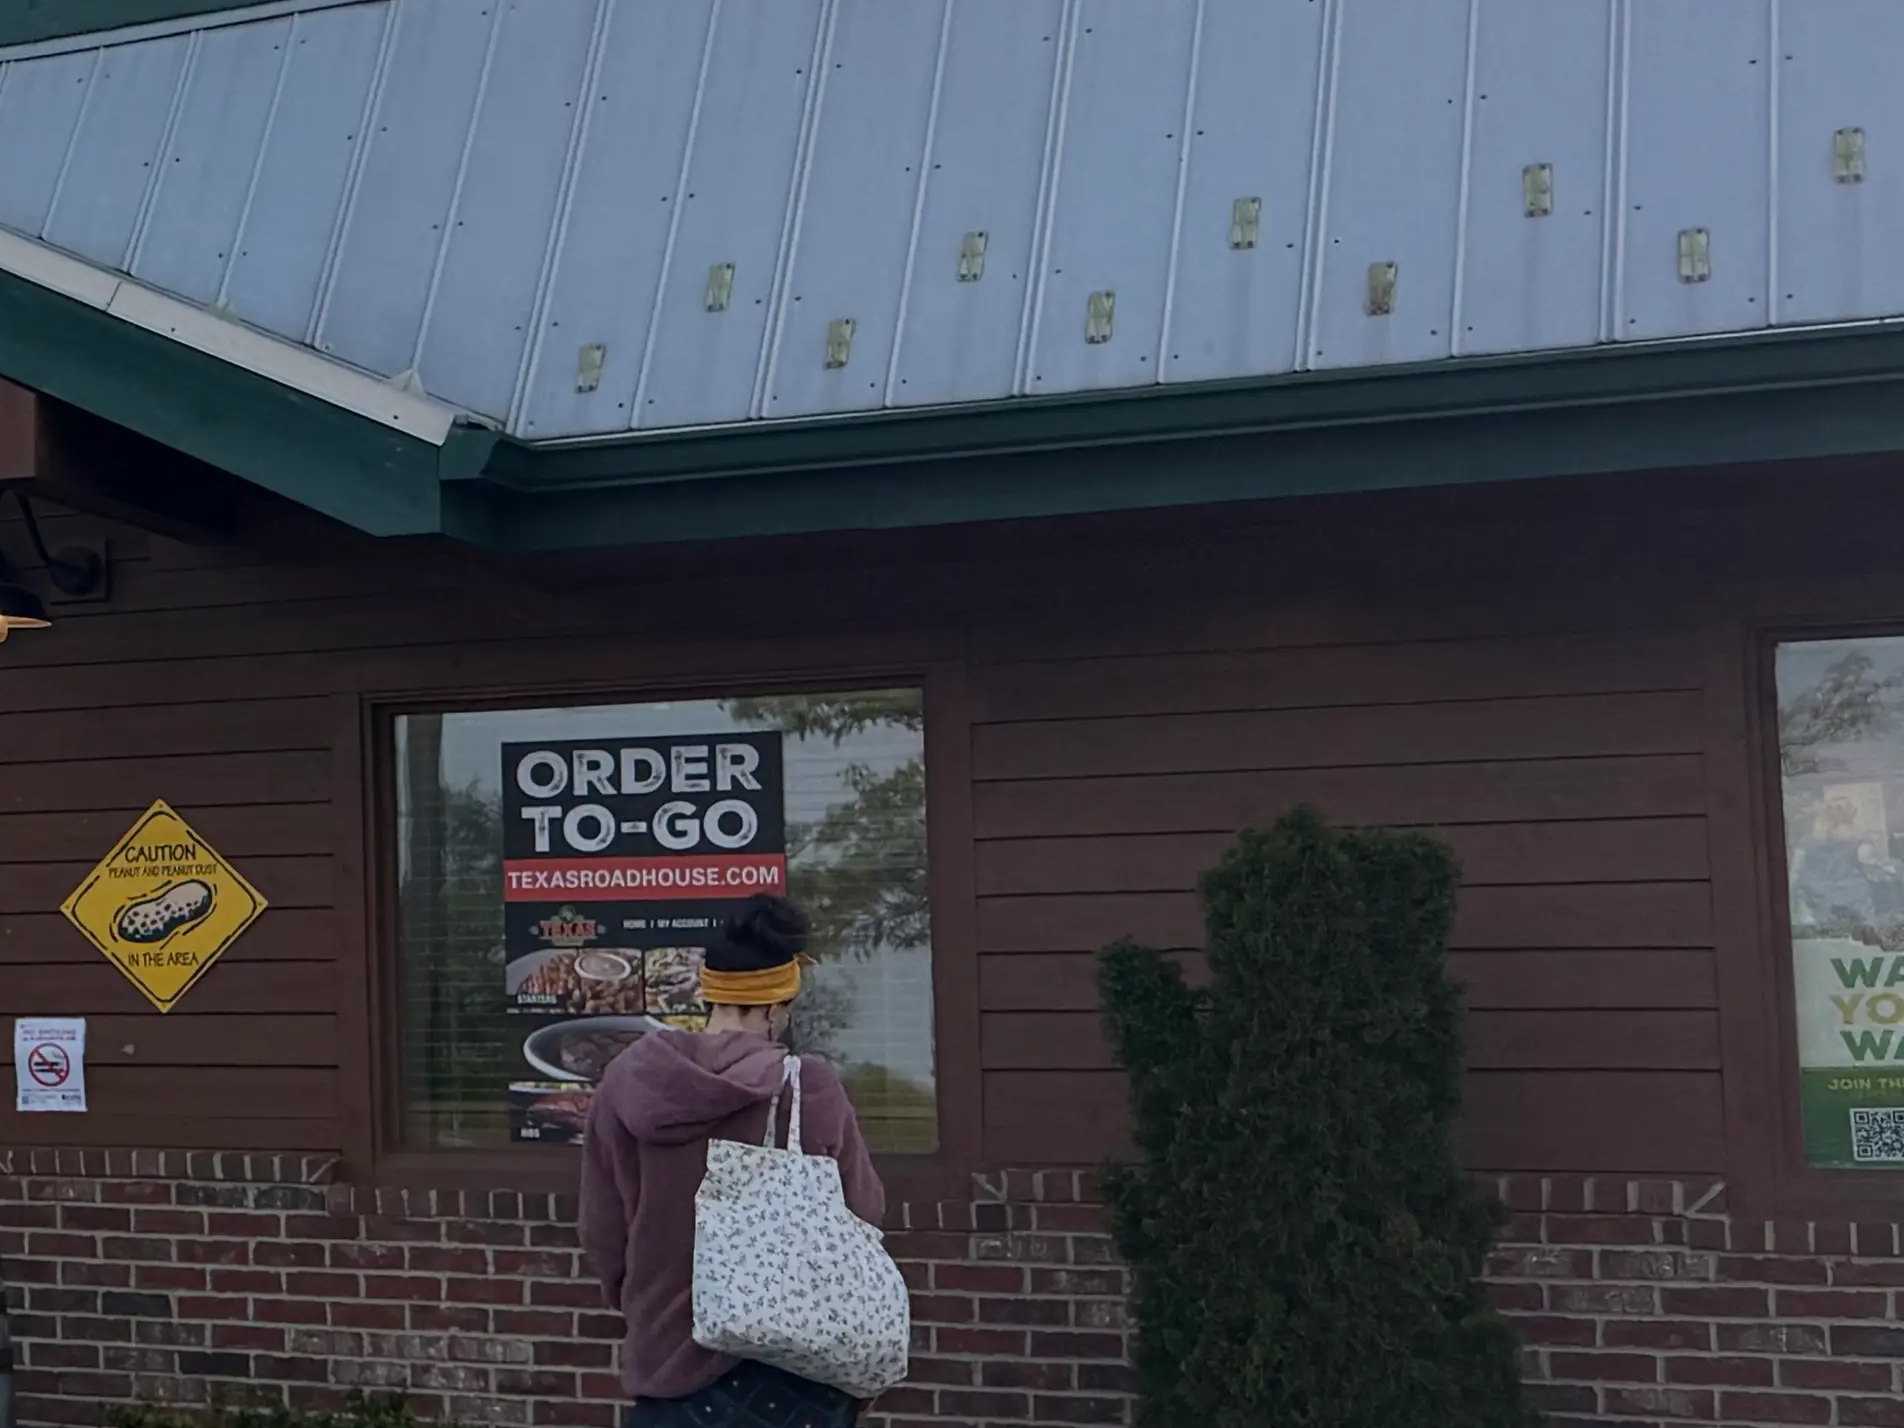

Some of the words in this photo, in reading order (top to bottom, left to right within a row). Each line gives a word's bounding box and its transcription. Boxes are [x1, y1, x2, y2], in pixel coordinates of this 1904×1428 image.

[516, 743, 762, 798] ORDER
[520, 800, 758, 853] TO-GO
[125, 844, 196, 863] CAUTION
[507, 866, 780, 890] TEXASROADHOUSE.COM
[128, 952, 139, 967] IN
[142, 952, 164, 967] THE
[167, 952, 199, 966] AREA
[1827, 1078, 1871, 1090] JOIN
